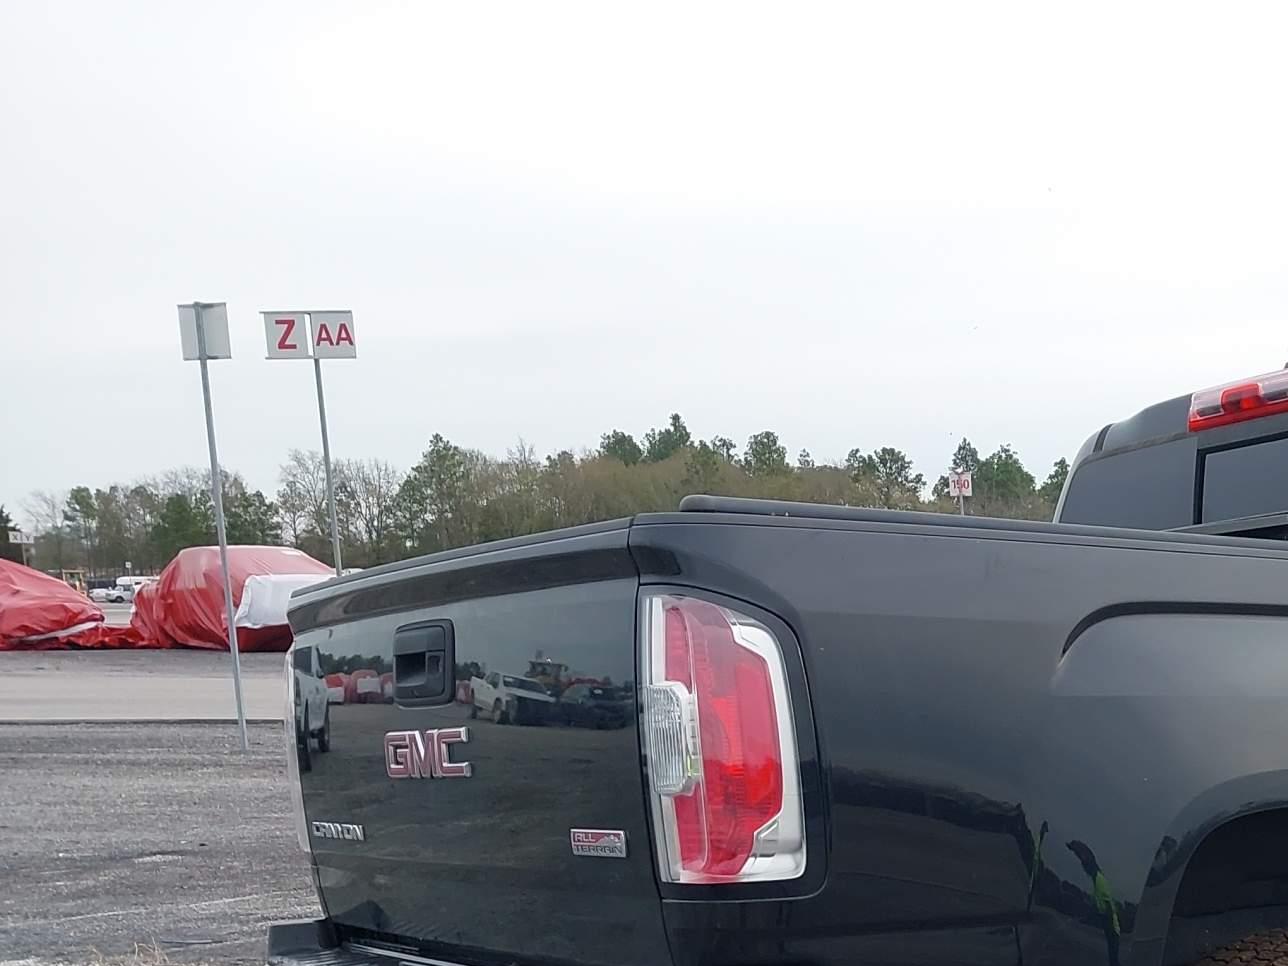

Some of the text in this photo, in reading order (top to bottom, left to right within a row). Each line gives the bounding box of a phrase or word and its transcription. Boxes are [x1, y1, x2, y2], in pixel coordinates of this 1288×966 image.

[274, 319, 298, 350] Z
[315, 323, 354, 347] AA
[384, 726, 472, 779] GMC
[574, 832, 597, 842] ALL
